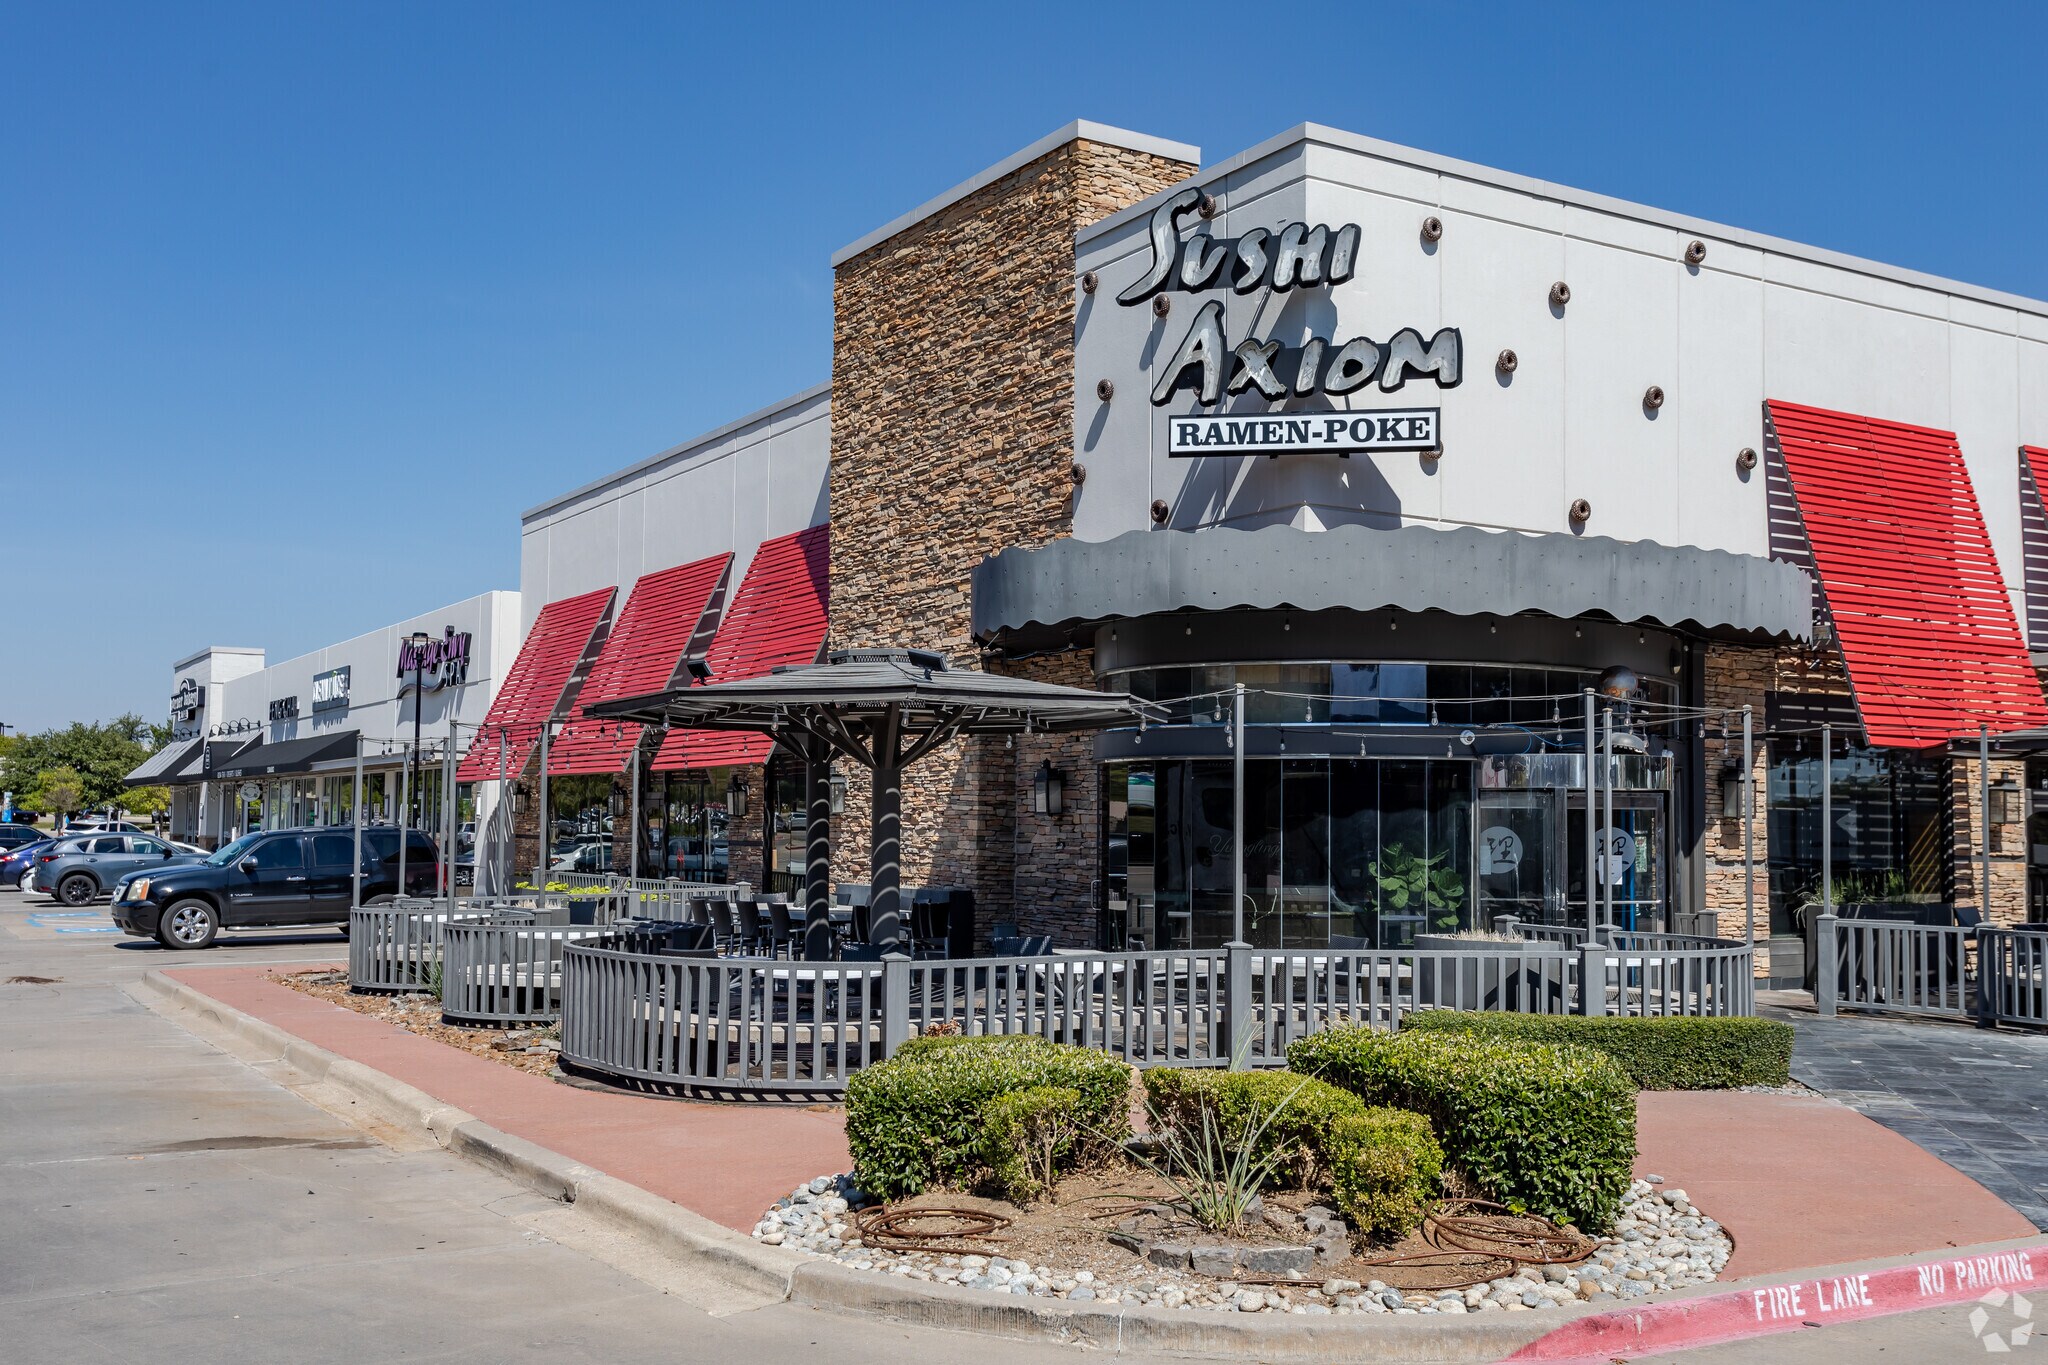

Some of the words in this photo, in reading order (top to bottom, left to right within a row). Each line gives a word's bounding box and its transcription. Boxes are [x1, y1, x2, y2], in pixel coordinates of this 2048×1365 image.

[1150, 299, 1464, 407] AXIOM
[1176, 416, 1430, 447] RAMEN-POKE
[1753, 1284, 1806, 1321] FIRE
[1816, 1275, 1873, 1312] LANE
[1917, 1264, 1945, 1296] NO
[1953, 1252, 2034, 1290] PARKING
